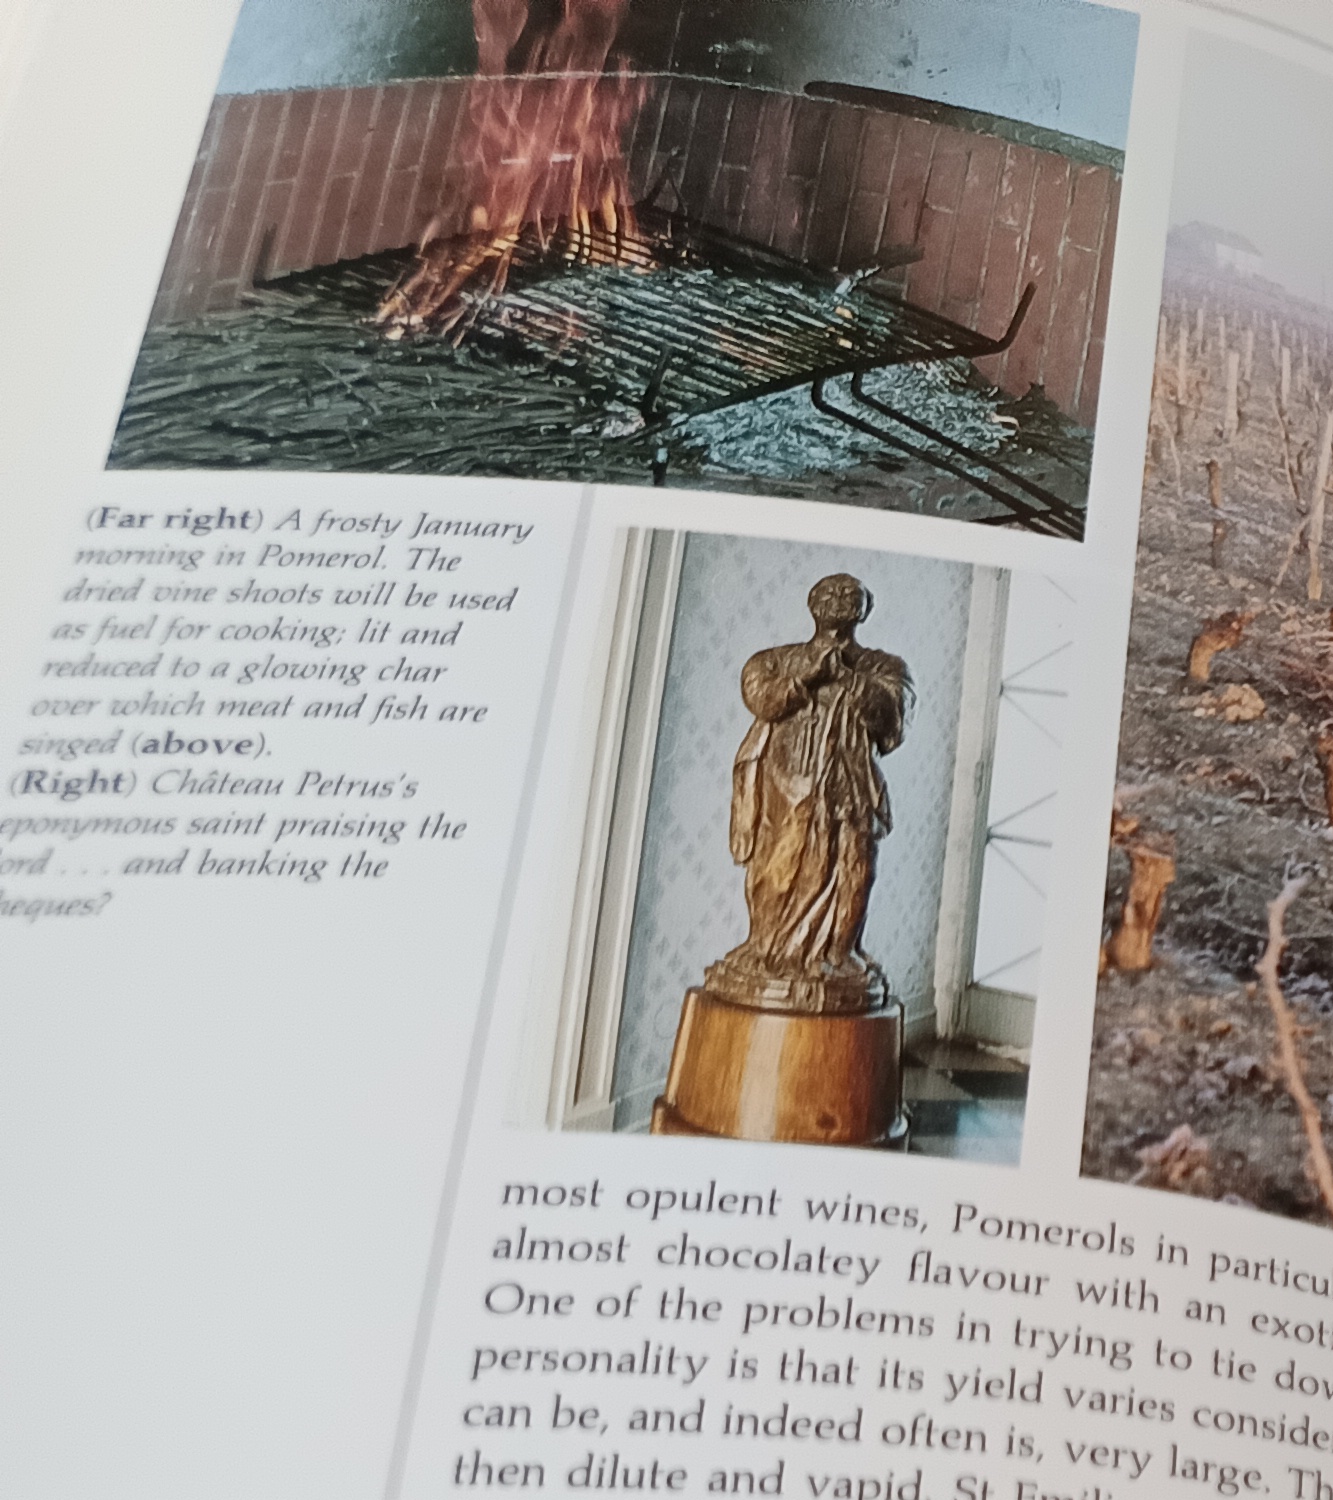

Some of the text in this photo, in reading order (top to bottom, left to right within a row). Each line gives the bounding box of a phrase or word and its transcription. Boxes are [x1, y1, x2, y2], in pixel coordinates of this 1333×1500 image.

[86, 505, 536, 545] (Far right) A frosty January
[74, 543, 463, 573] morning in Pomerol. The
[51, 613, 465, 649] as fuel for cooking; lit and
[9, 767, 420, 802] (Right) Château Petrus's
[185, 810, 267, 836] saint
[273, 812, 408, 845] praising
[417, 810, 468, 841] the
[501, 1178, 600, 1209] most
[625, 1179, 778, 1222] opulent
[805, 1192, 929, 1235] wines,
[951, 1202, 1136, 1257] Pomerols
[1155, 1233, 1189, 1267] in
[491, 1225, 626, 1264] almost
[656, 1231, 881, 1287] chocolatey
[907, 1249, 1050, 1297] flavour
[1075, 1277, 1160, 1314] with
[1184, 1299, 1226, 1326] an
